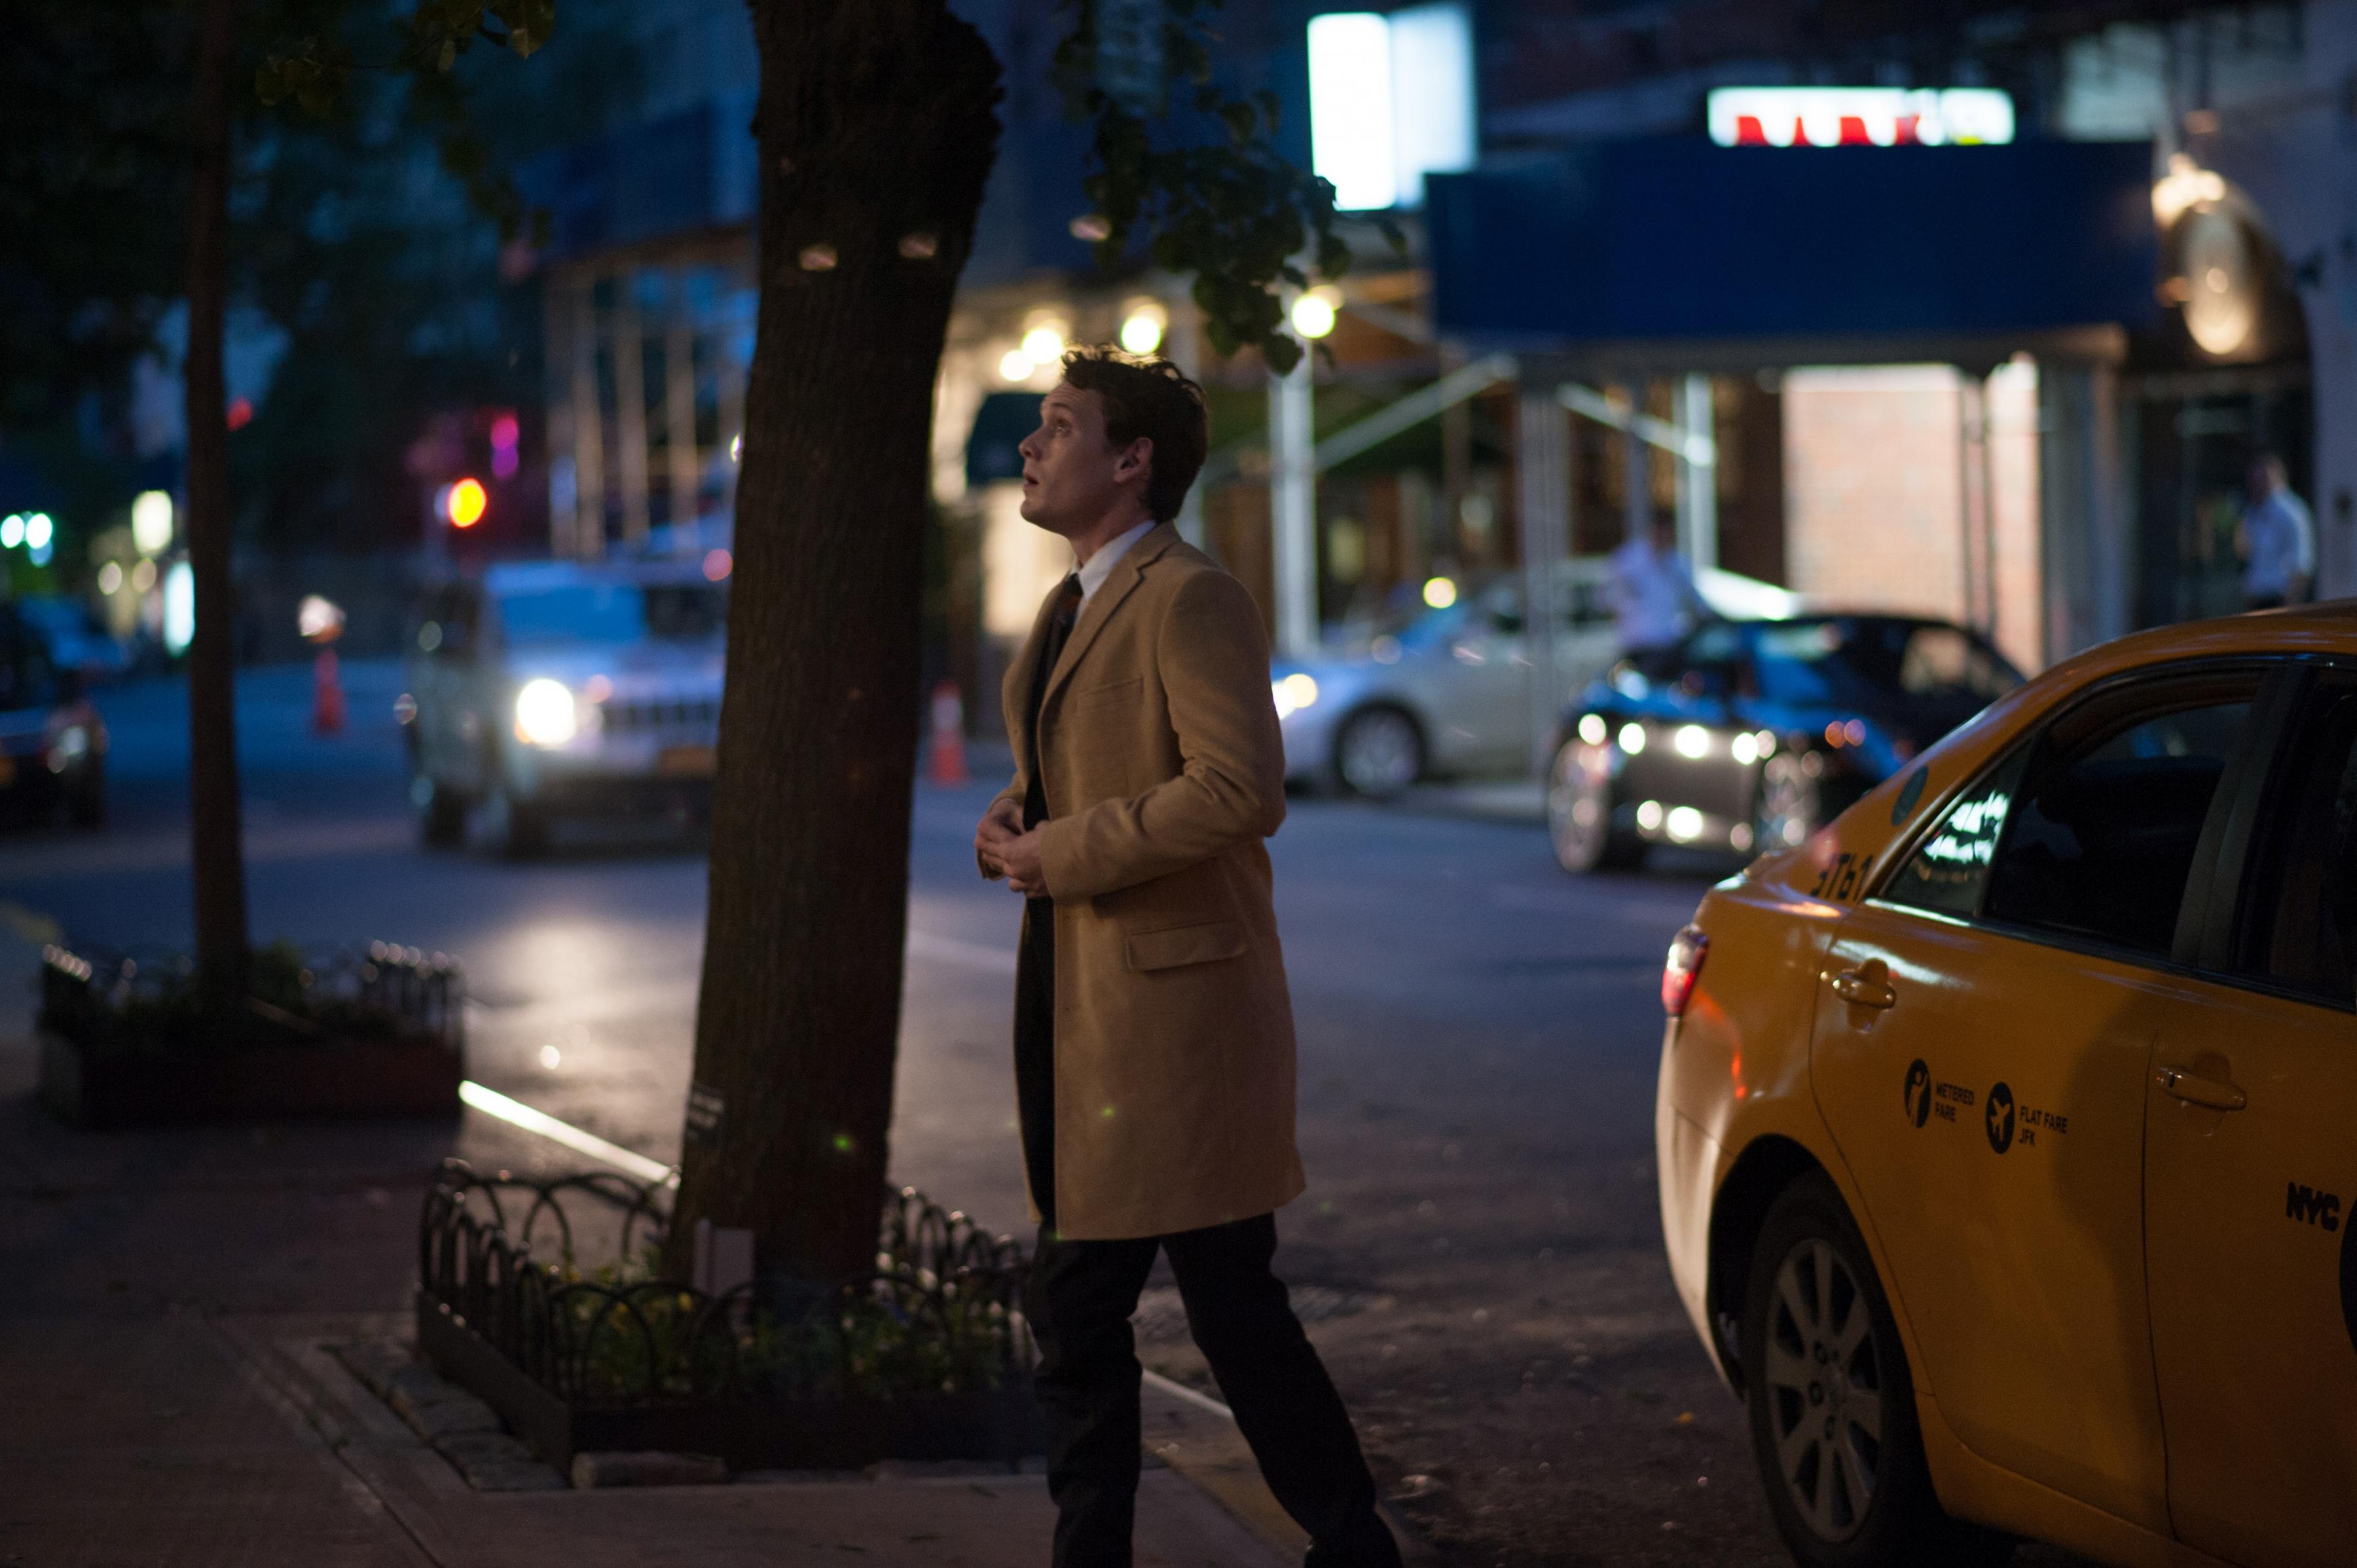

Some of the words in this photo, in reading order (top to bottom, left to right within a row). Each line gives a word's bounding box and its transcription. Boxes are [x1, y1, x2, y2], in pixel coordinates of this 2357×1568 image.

[1936, 1082, 1975, 1106] METERED
[1935, 1101, 1956, 1123] FARE
[2020, 1105, 2042, 1126] FLAT
[2043, 1112, 2068, 1134] FARE
[2019, 1128, 2036, 1146] JFK
[2287, 1182, 2339, 1231] NYC
